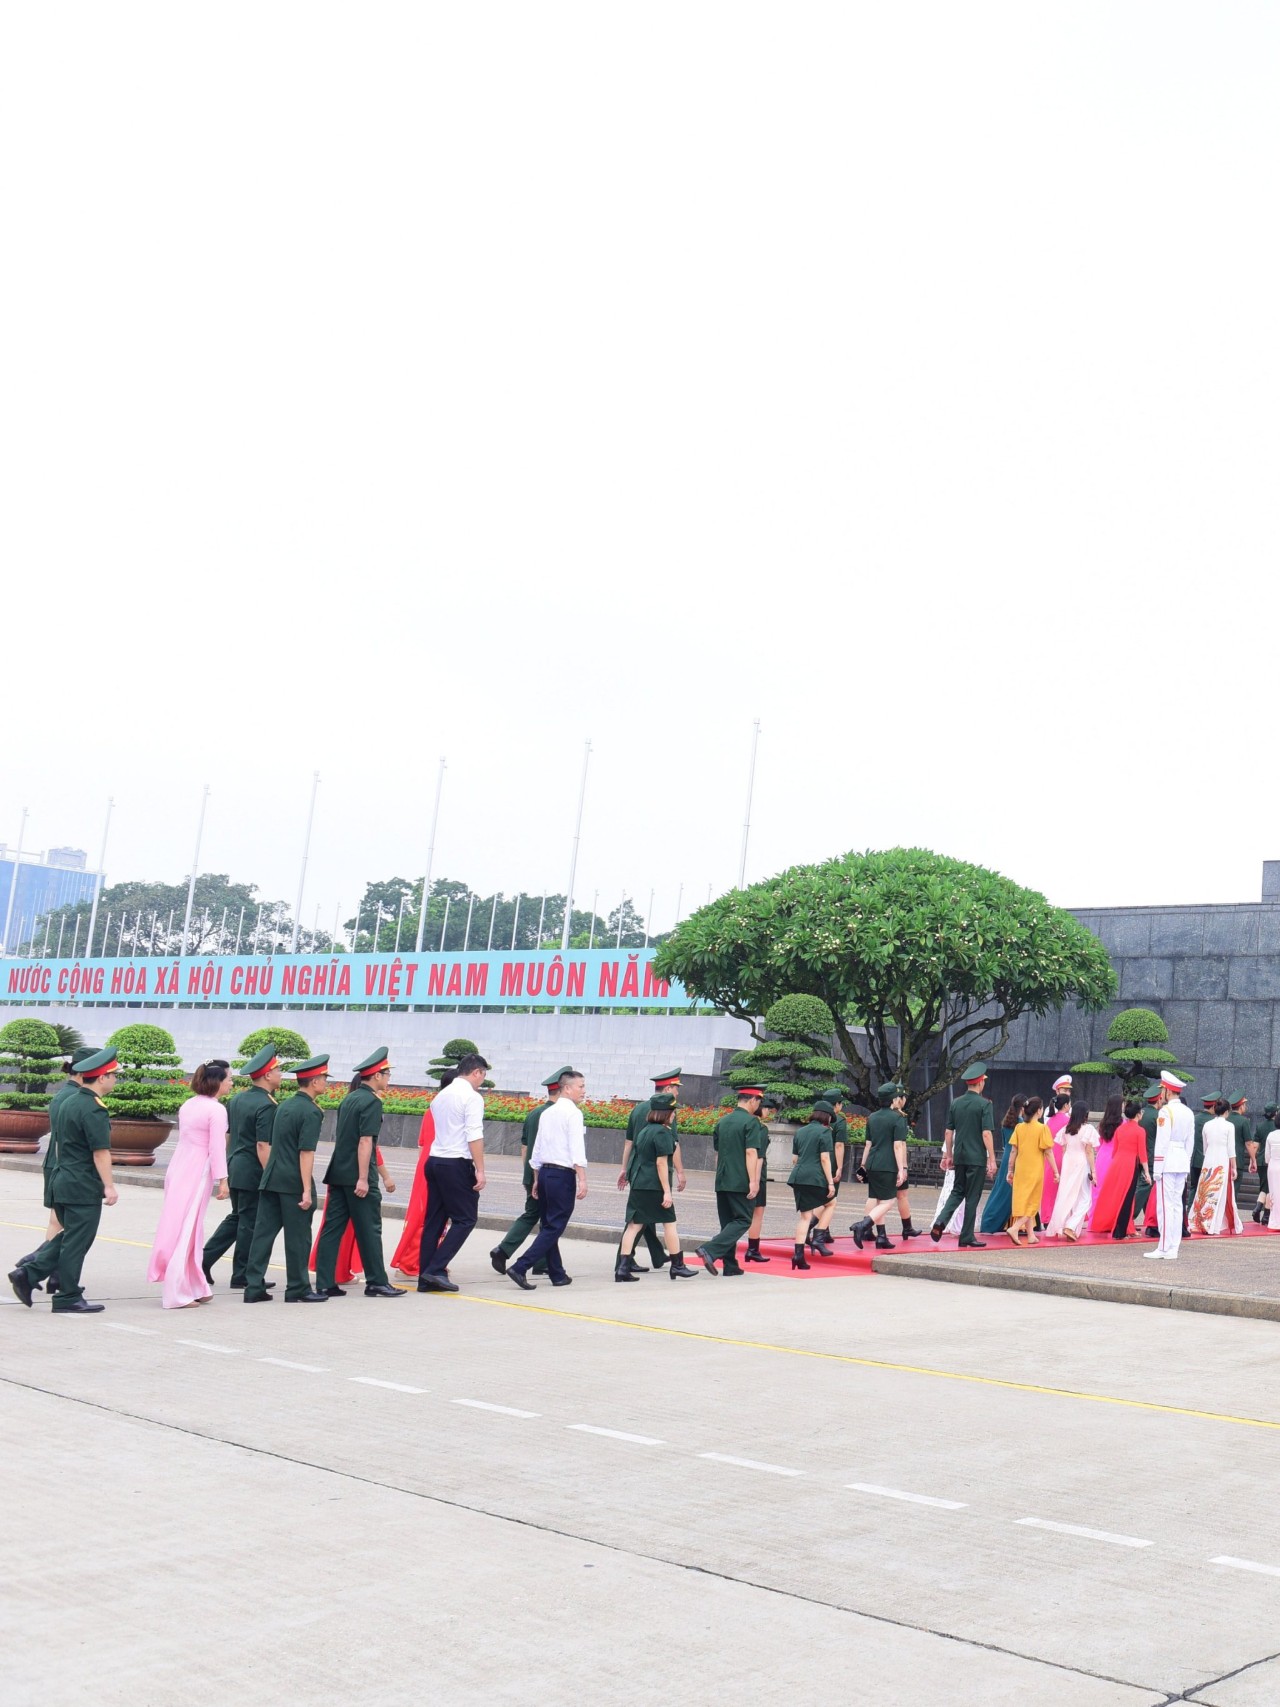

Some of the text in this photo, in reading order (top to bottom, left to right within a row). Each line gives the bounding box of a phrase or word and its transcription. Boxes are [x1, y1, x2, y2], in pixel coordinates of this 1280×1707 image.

[7, 954, 669, 1002] NƯỚC CỘNG HÒA XÃ HỘI CHỦ NGHĨA VIỆT NAM MUÔN NĂM
